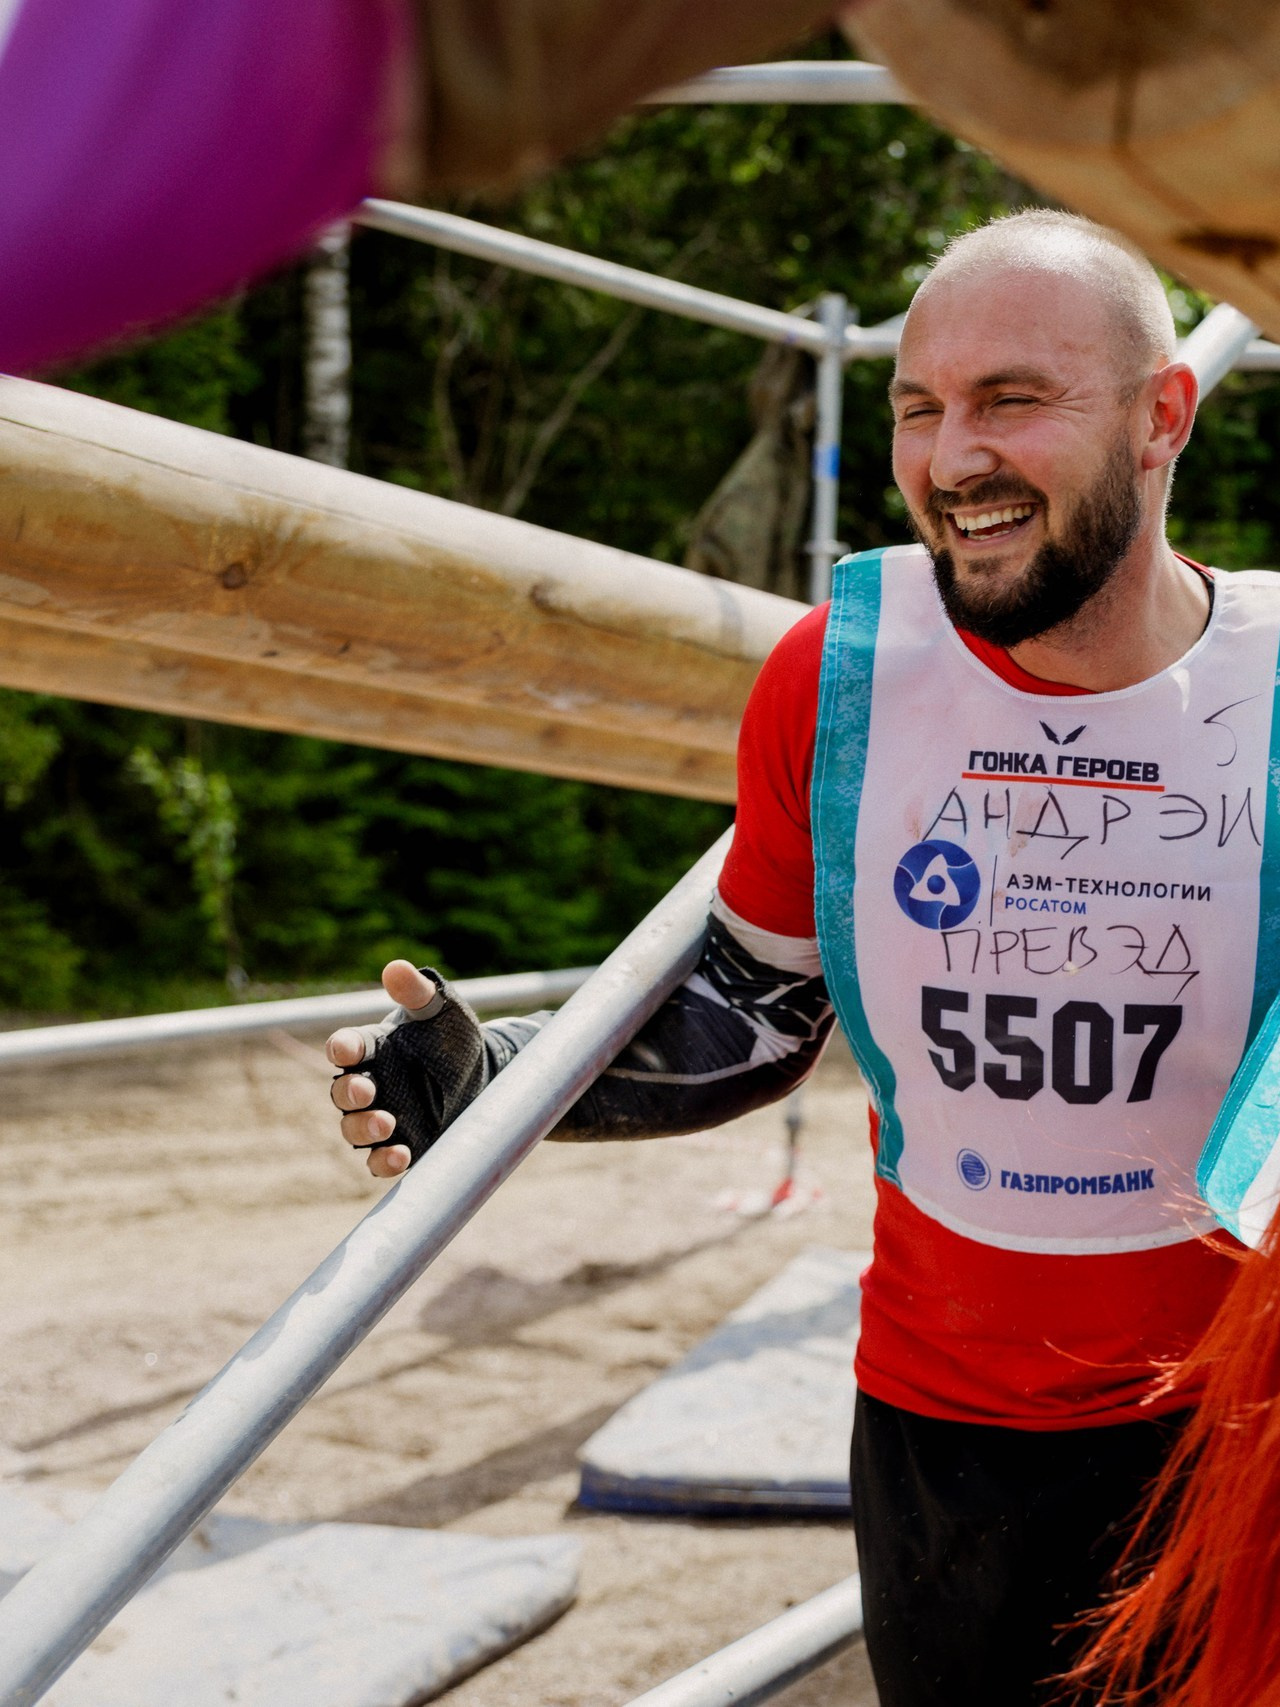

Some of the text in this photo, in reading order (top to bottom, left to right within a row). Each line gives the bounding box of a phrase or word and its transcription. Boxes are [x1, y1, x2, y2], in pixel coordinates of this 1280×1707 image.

[968, 750, 1161, 783] ГОНКА ГЕРОЕВ
[1006, 873, 1212, 902] АЭМ-ТЕХНОЛОГИИ
[1004, 906, 1087, 915] РОСАТОМ
[921, 985, 1183, 1105] 5507
[1000, 1168, 1155, 1195] ГАЗПРОМБАНК
